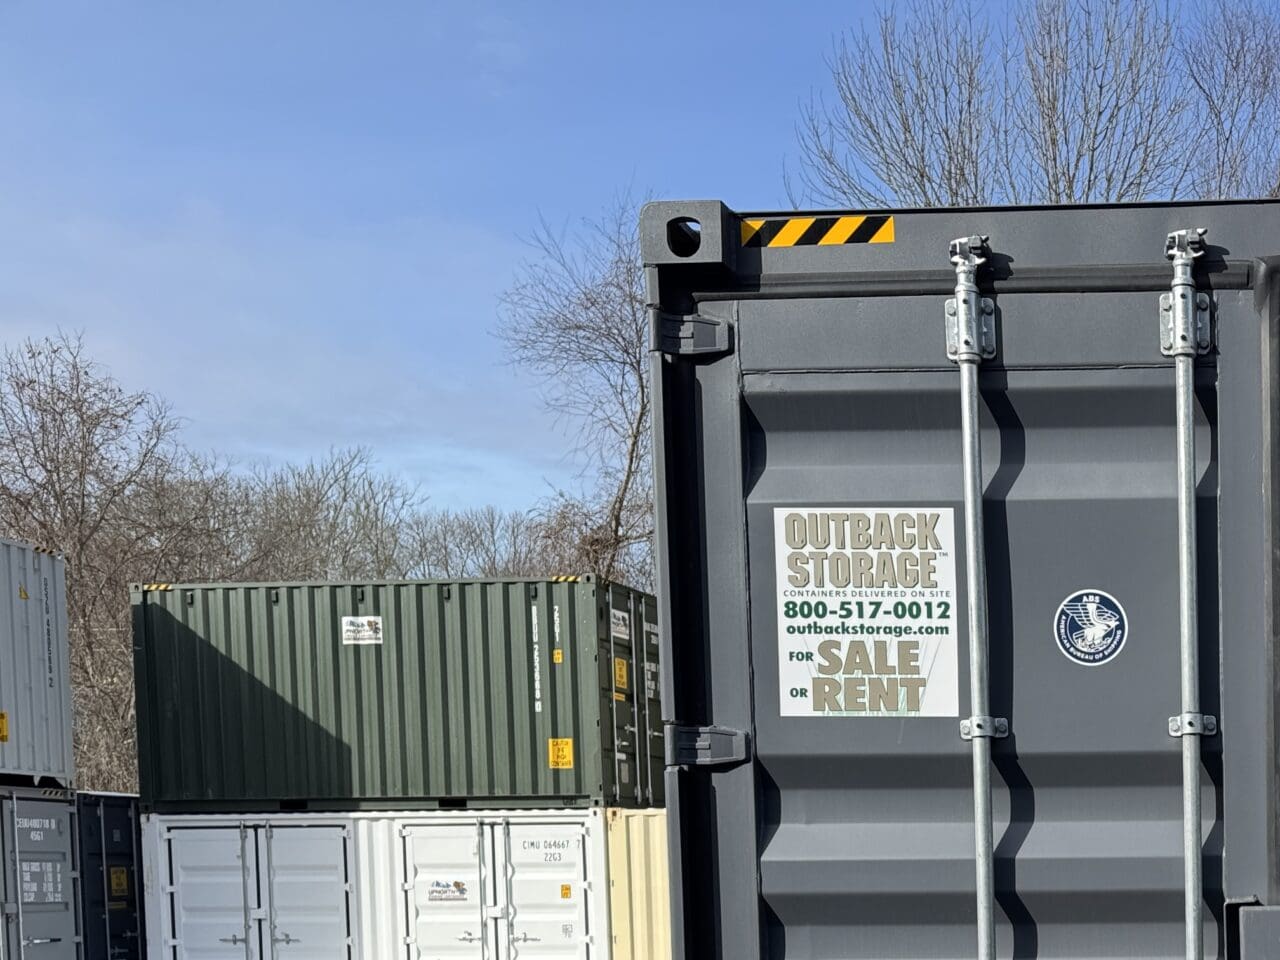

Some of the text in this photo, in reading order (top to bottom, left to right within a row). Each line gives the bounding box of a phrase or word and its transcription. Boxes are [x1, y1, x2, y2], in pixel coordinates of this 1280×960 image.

[784, 512, 942, 550] OUTBACK
[786, 551, 938, 588] STORAGE
[783, 589, 951, 598] CONTAINERS DELIVERED ON SITE
[1082, 595, 1100, 603] ABS
[783, 601, 951, 619] 800-517-0012
[786, 621, 949, 637] outbackstorage.com
[789, 639, 920, 675] FOR SALE
[790, 677, 926, 711] OR RENT
[522, 840, 540, 849] CIMU
[543, 839, 569, 849] 064667
[544, 852, 562, 862] 22G3
